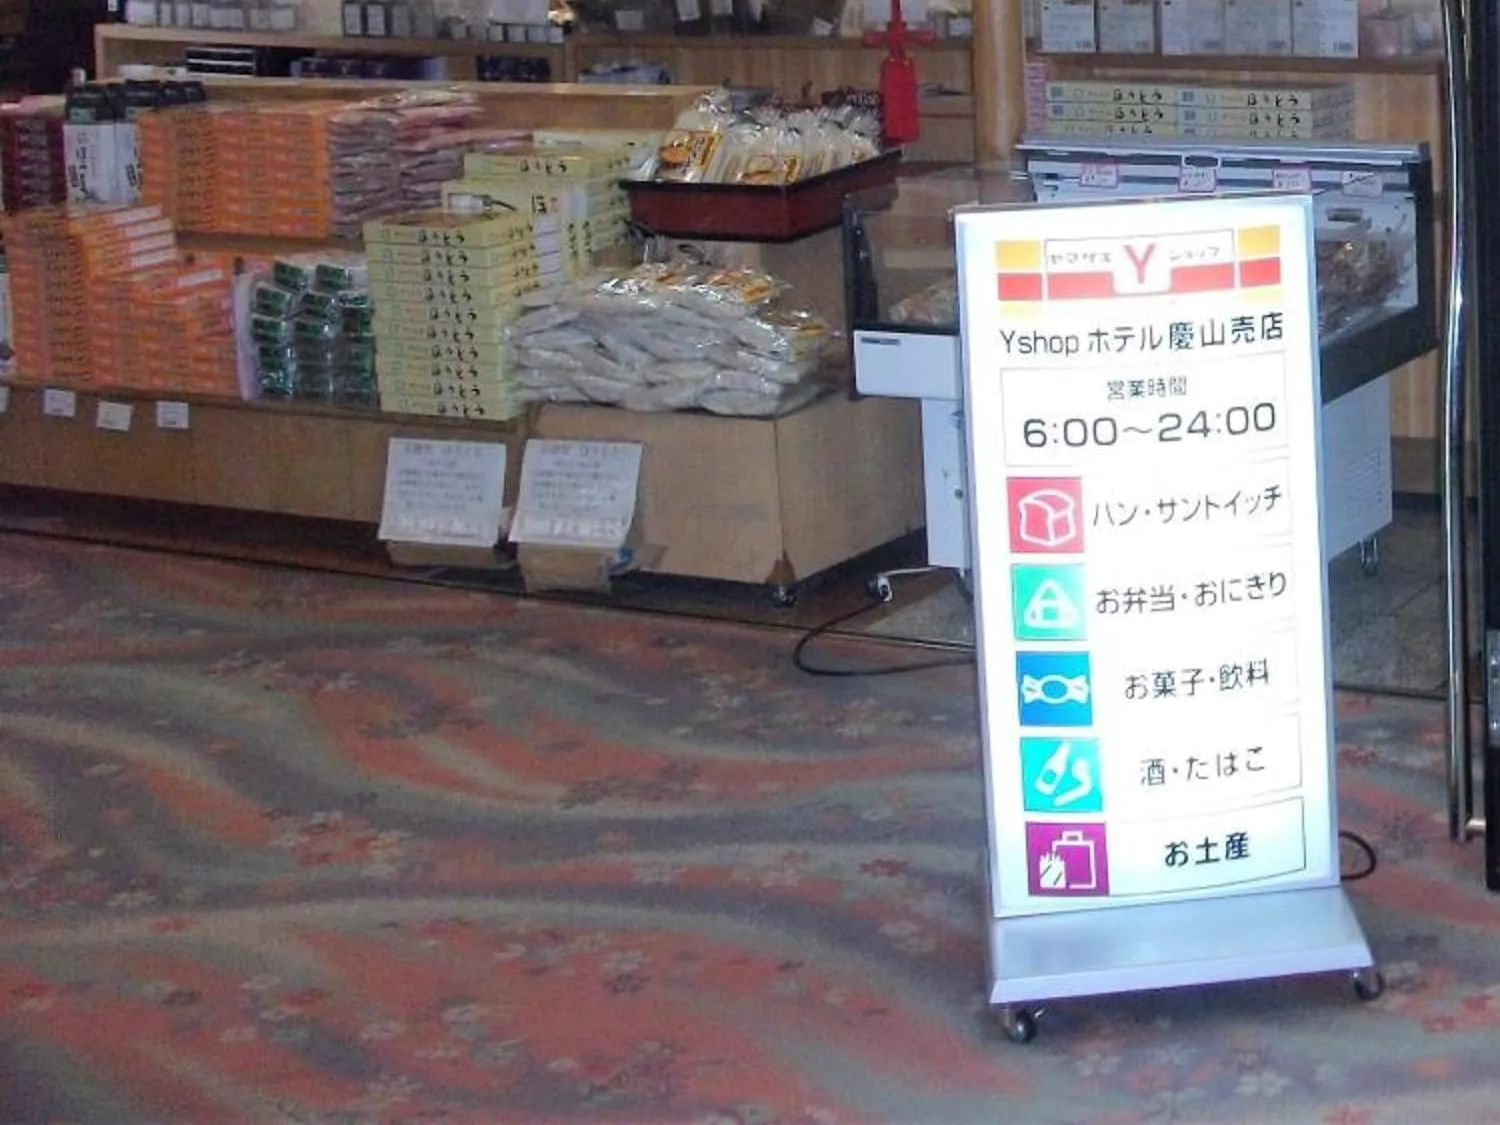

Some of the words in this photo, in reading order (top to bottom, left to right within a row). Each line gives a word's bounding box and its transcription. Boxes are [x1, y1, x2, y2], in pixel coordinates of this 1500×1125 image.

[1122, 242, 1157, 285] Y
[1000, 328, 1080, 358] Yshop
[1106, 375, 1188, 401] 営業時間
[1124, 658, 1270, 701] お菓子・飲料
[1163, 831, 1252, 869] お土産
